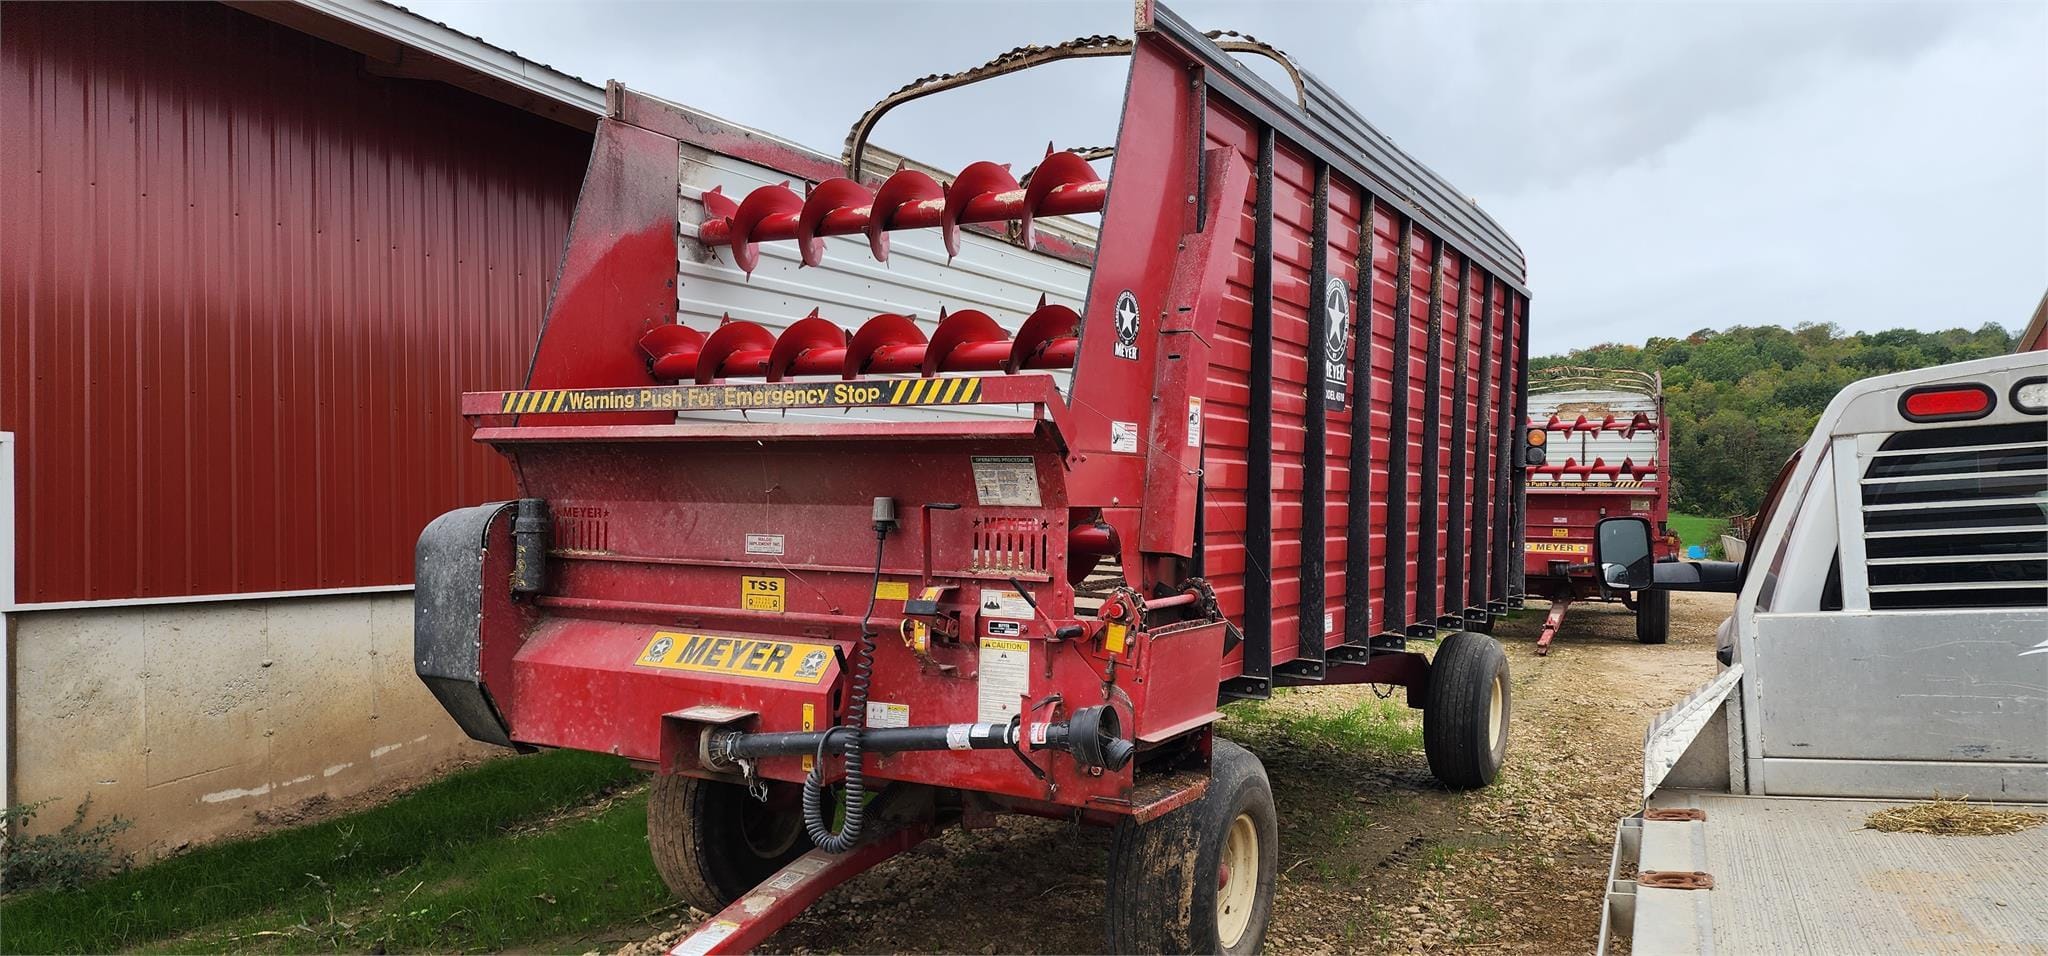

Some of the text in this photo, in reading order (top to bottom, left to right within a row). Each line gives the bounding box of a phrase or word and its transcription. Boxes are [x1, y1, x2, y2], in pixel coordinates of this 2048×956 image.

[1115, 342, 1138, 360] MEYER
[569, 383, 881, 409] Warning Push For Emergency Stop
[563, 507, 602, 518] MEYER
[984, 517, 1039, 531] MEYER
[749, 580, 778, 591] TSS
[991, 641, 1022, 650] CAUTION
[675, 636, 794, 673] MEYER
